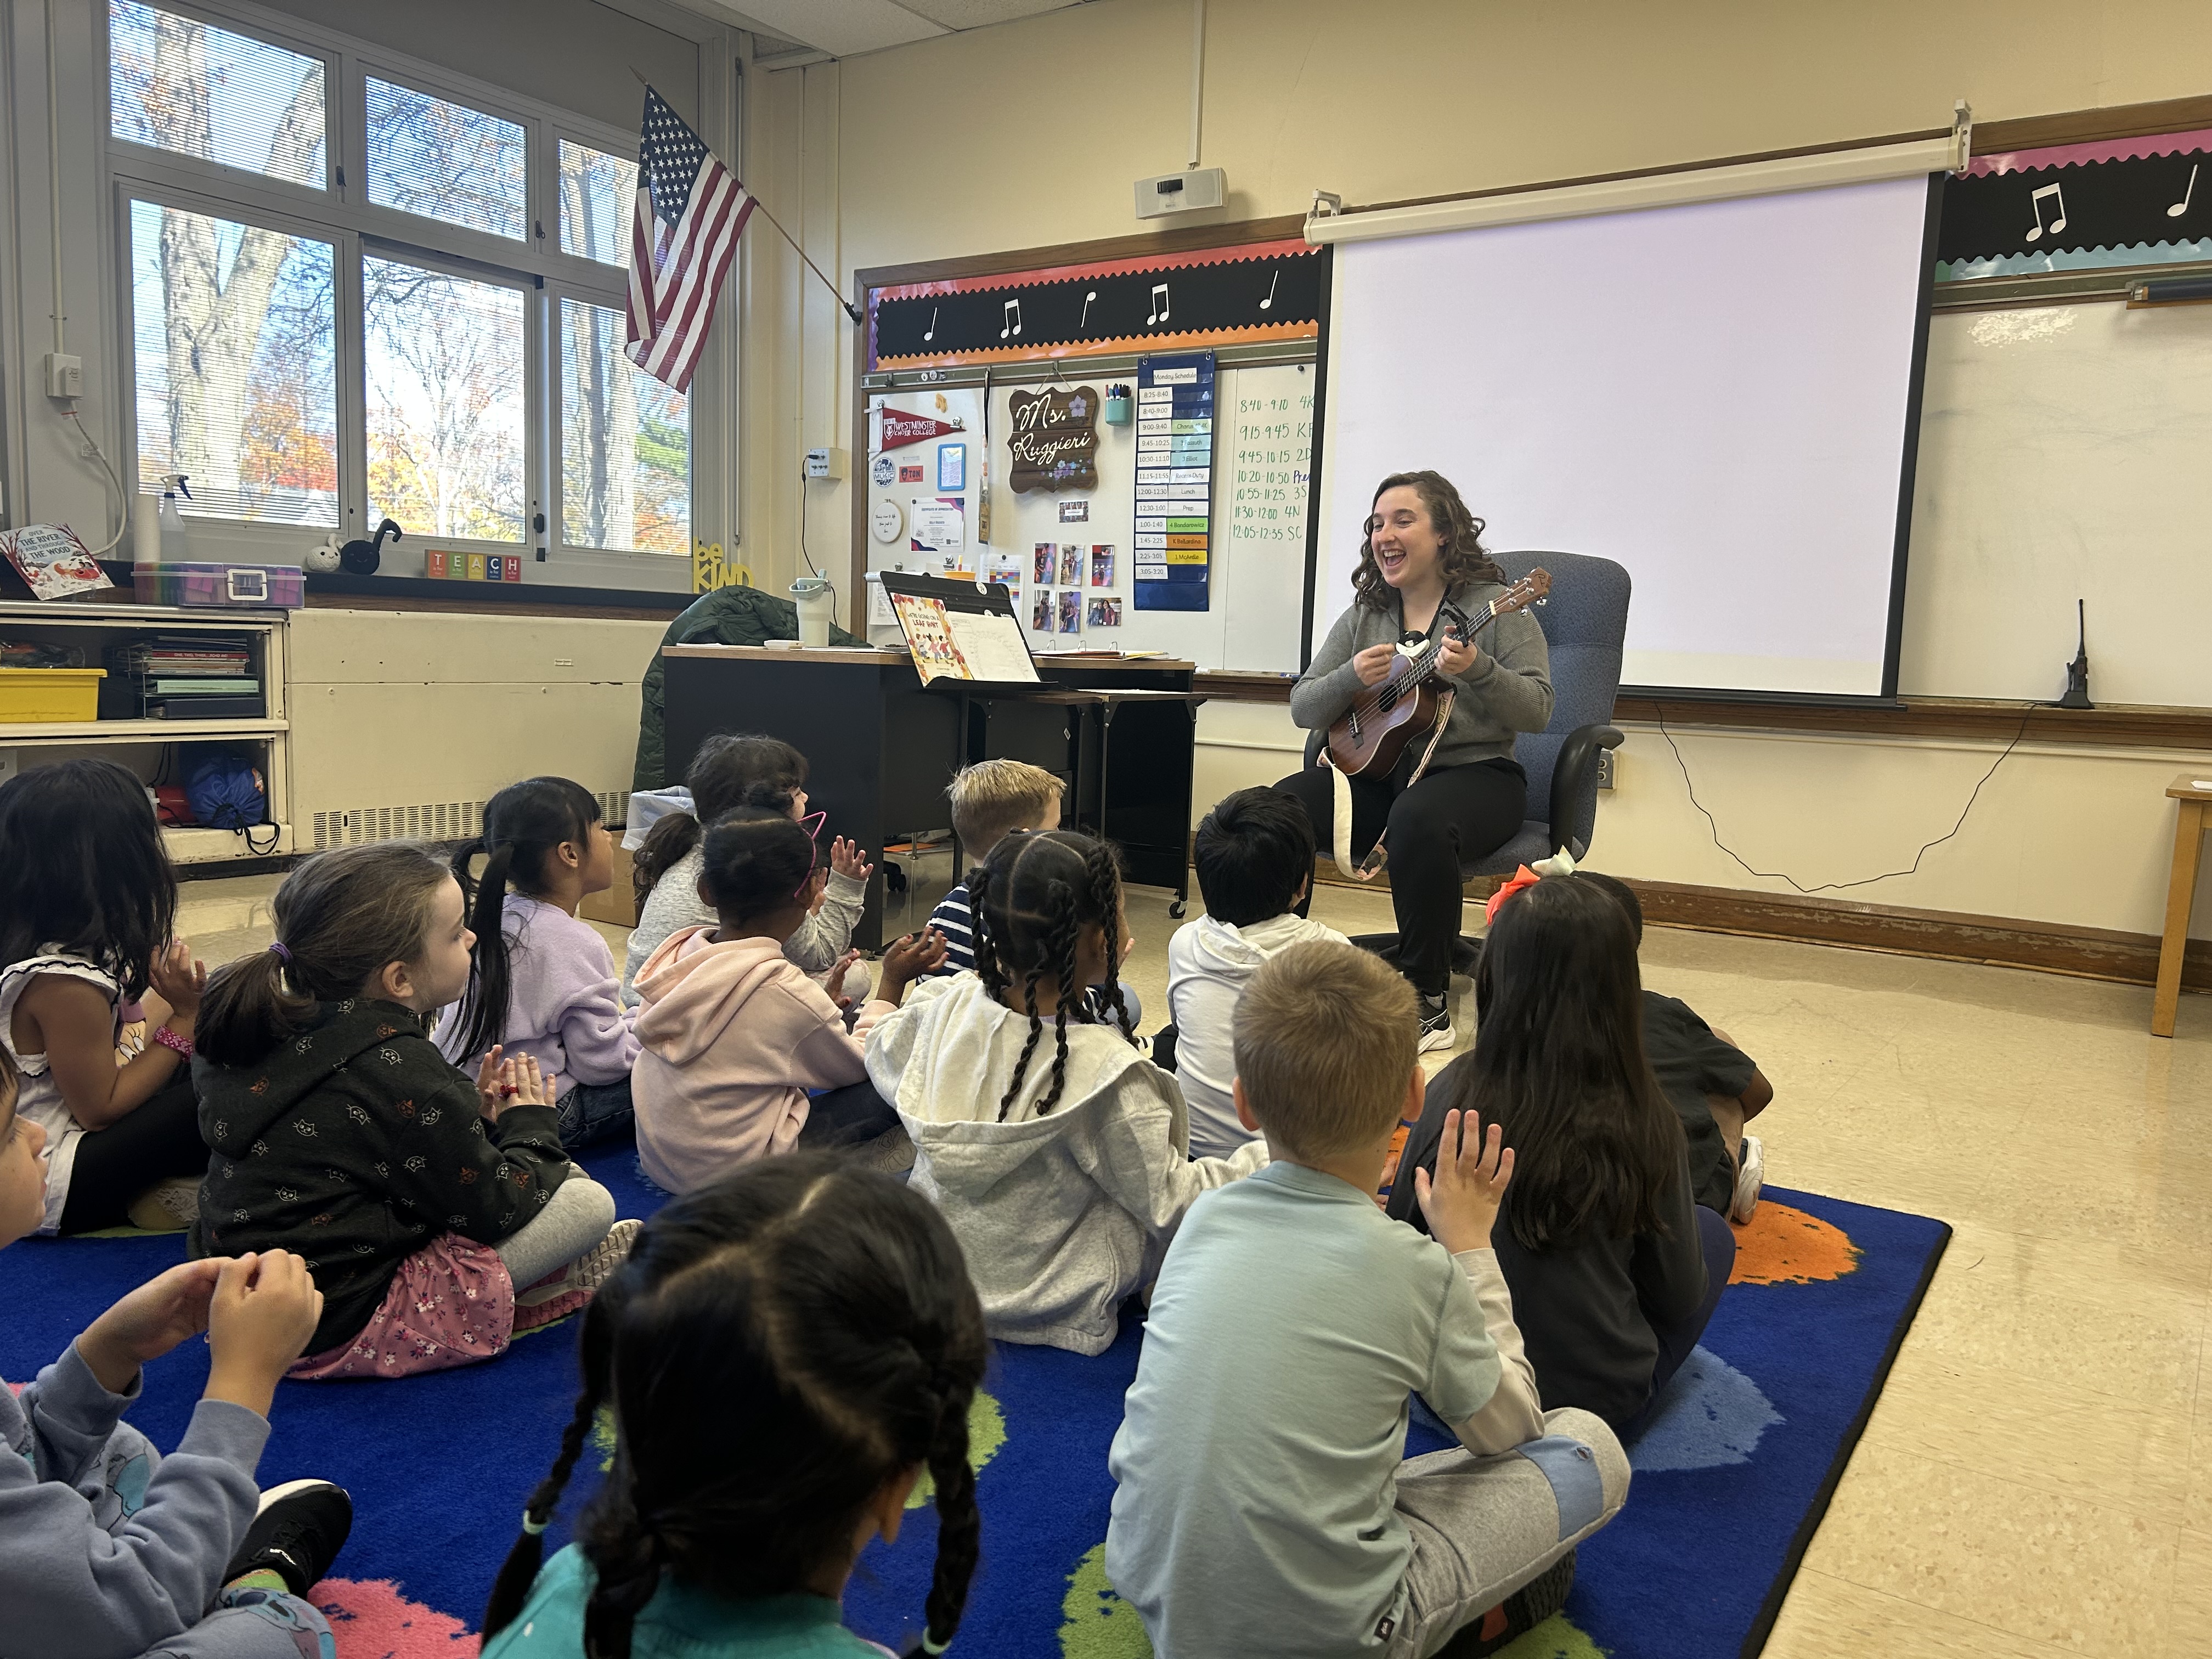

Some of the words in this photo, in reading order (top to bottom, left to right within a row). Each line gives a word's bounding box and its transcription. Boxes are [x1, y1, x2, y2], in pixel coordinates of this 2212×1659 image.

[1300, 396, 1314, 409] 4K
[1016, 393, 1066, 431] Ms.
[895, 421, 936, 430] WESTMINSTER
[1013, 432, 1091, 465] Ruggieri
[1296, 448, 1312, 461] 2D
[909, 470, 921, 478] TON
[1238, 470, 1289, 484] 10:20-10:50
[1237, 488, 1285, 501] 10:55-11:25
[1294, 485, 1307, 500] 3S
[1235, 505, 1277, 520] 11:30-12:00
[1285, 505, 1300, 518] 4N
[1234, 524, 1283, 540] 12:05-12:35
[1288, 526, 1302, 541] SC
[19, 538, 37, 546] THE
[38, 533, 60, 543] RIVER
[38, 540, 65, 549] THROUGH
[29, 551, 47, 559] THE
[47, 546, 70, 555] WOOD
[693, 537, 724, 564] be
